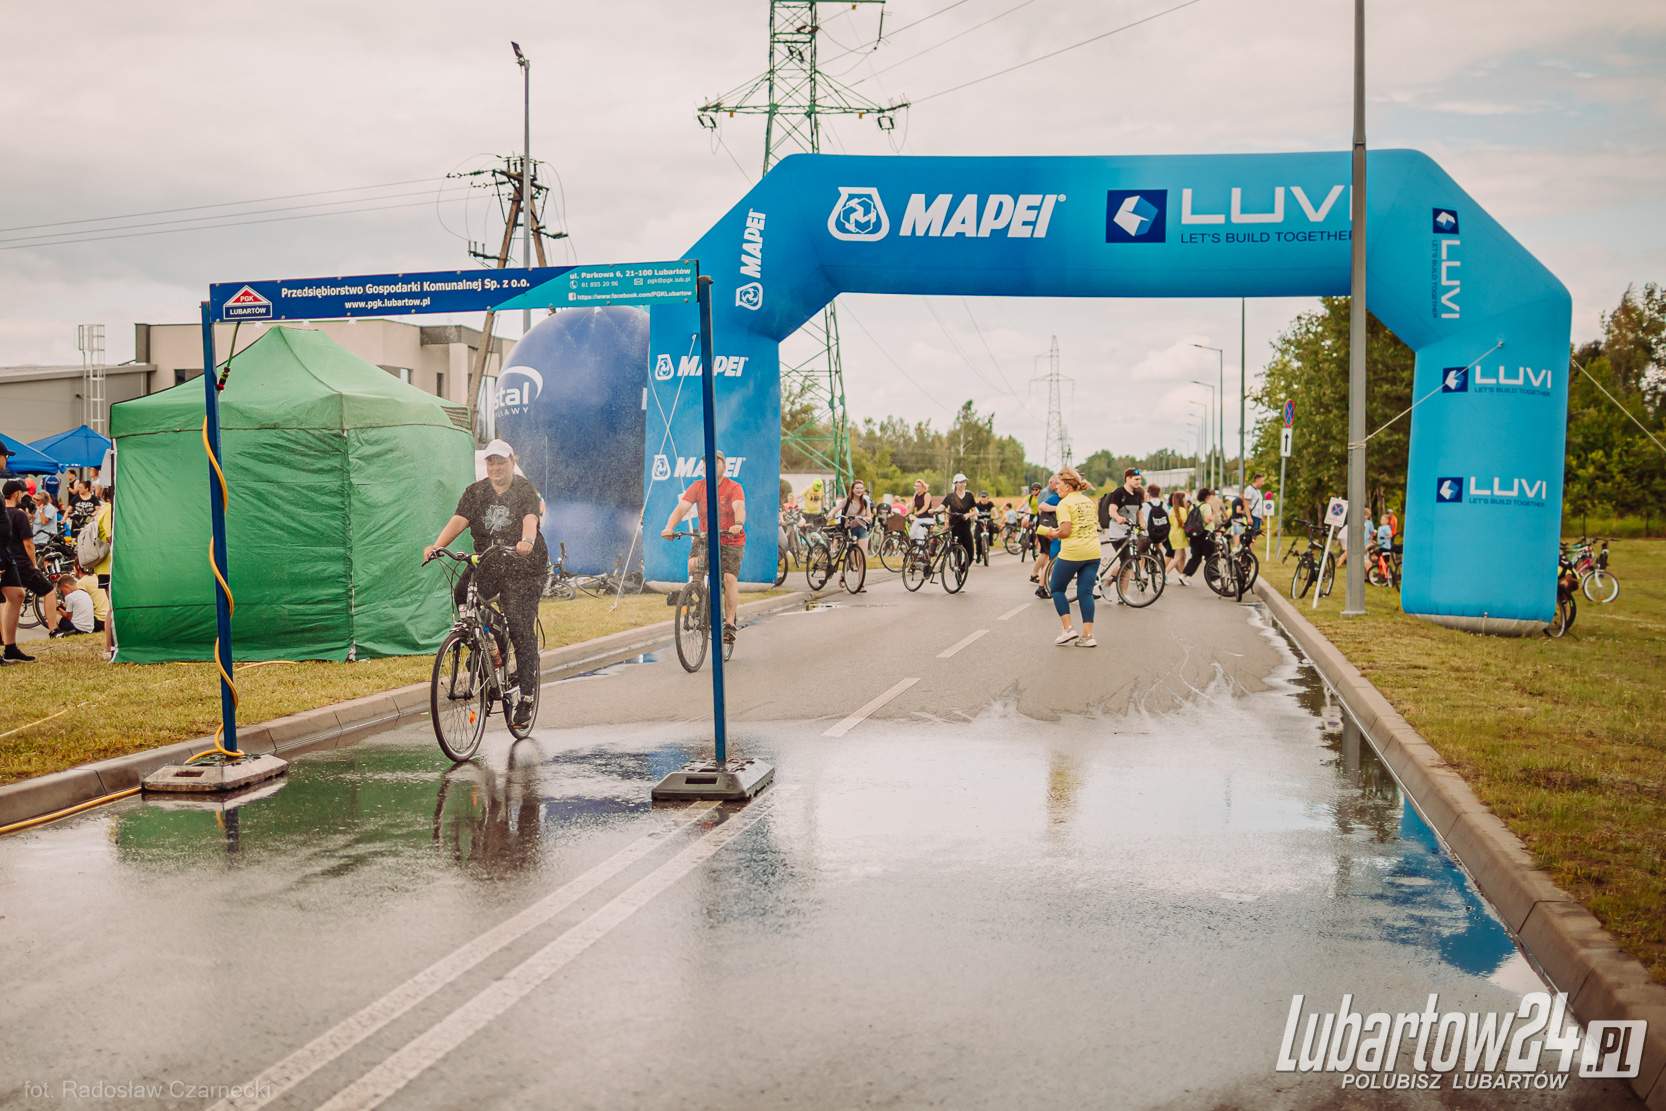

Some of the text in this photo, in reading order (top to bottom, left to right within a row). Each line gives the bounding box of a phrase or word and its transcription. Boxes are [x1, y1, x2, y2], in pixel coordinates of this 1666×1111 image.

[1181, 184, 1352, 224] LUV
[899, 193, 1059, 238] MAPEI
[740, 210, 768, 278] MAPEI
[1180, 232, 1221, 244] LET'S
[1225, 231, 1270, 243] BUILD
[581, 271, 615, 279] Parkowa
[626, 269, 653, 277] 21-100
[654, 268, 691, 276] Lubartów
[1441, 239, 1461, 319] LUVI
[281, 278, 530, 298] Przedsiębiorstwo Gospodarki Komunalnej Sp. z o.o.
[229, 307, 267, 315] LUBARTÓW
[344, 297, 431, 309] www.pgk.lubartow.pl
[677, 355, 748, 377] MPEI
[1474, 365, 1552, 389] LUVI
[673, 456, 745, 478] MAEI
[1469, 476, 1547, 500] LUVI
